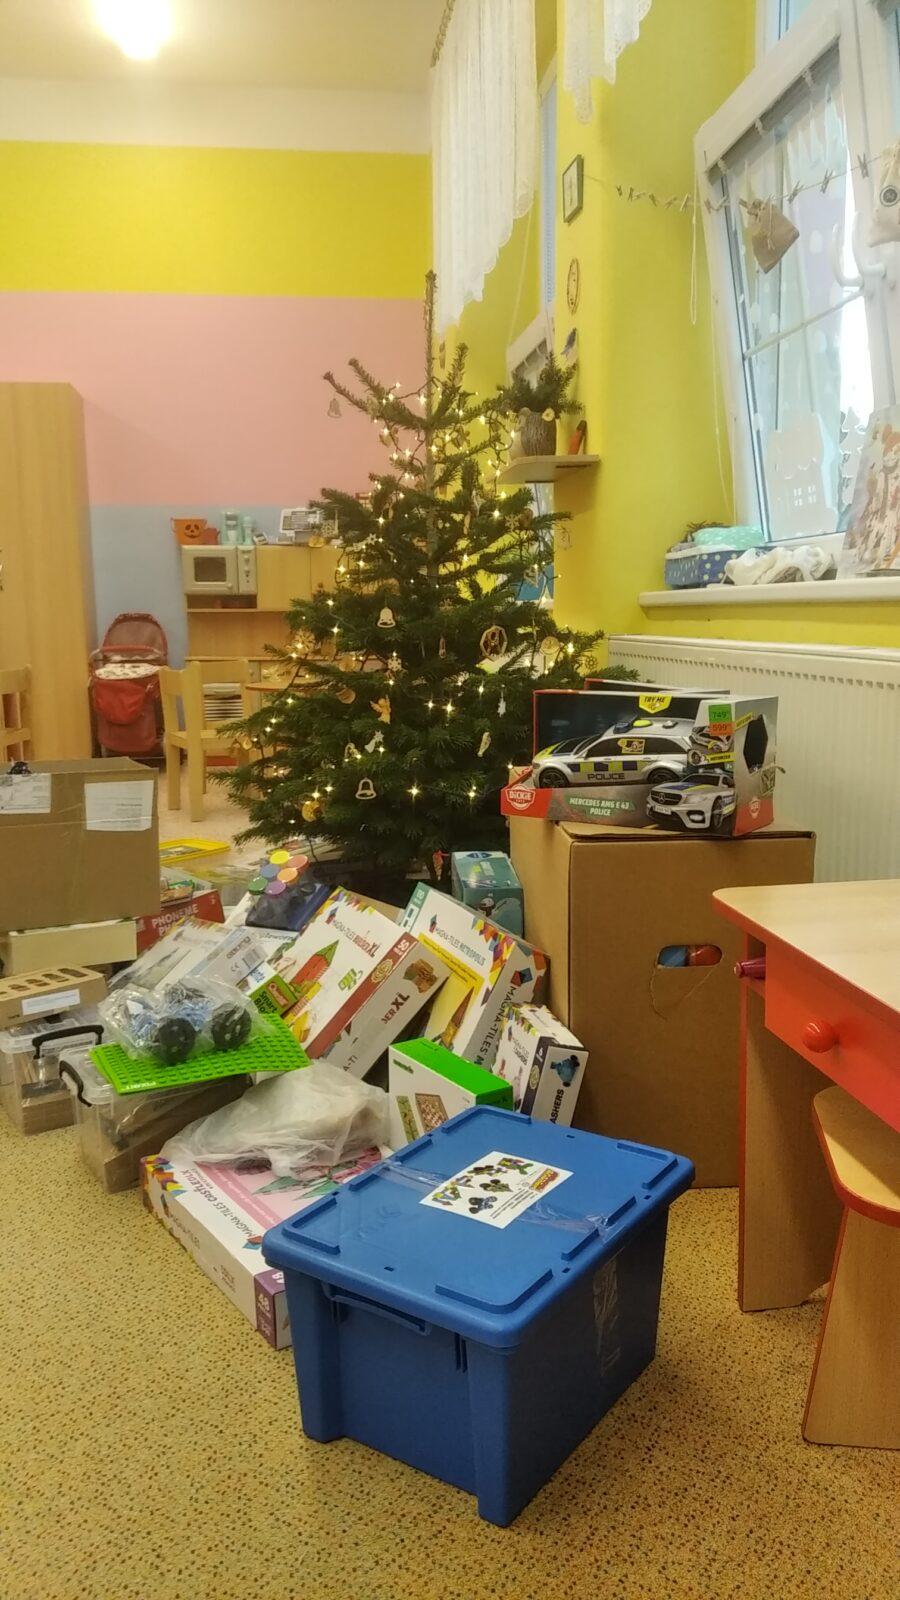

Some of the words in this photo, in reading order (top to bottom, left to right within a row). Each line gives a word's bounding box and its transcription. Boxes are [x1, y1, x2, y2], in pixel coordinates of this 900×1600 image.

[587, 772, 625, 780] POLICE
[569, 797, 600, 807] MERCEDES
[600, 800, 615, 808] AMG
[590, 807, 611, 816] POLICE
